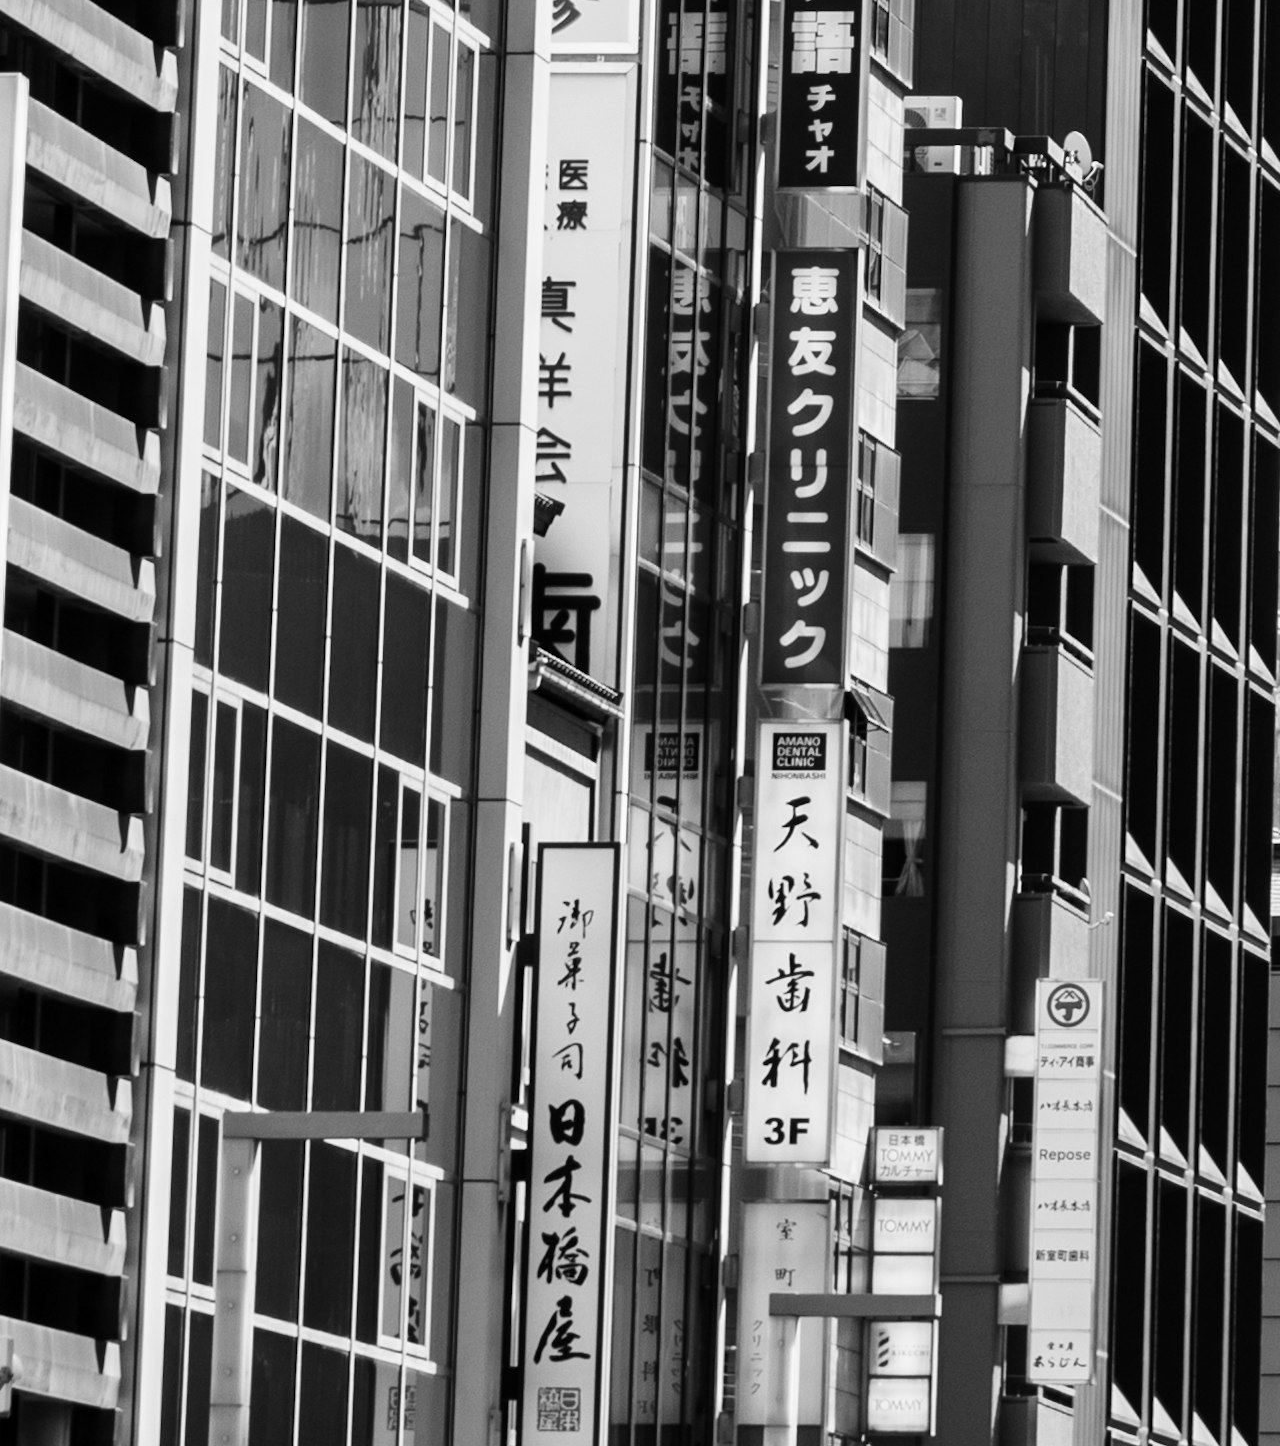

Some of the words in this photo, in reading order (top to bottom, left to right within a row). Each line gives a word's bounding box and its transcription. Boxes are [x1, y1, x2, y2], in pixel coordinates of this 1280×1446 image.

[805, 84, 837, 175] チャオ
[779, 265, 844, 670] 恵友クリニック
[777, 736, 821, 746] AMANO
[776, 746, 822, 757] DENTAL
[776, 756, 815, 767] CLINIC
[760, 796, 822, 1097] 天野歯科
[763, 1117, 810, 1147] 3F
[888, 1134, 926, 1146] 日本橋
[880, 1148, 934, 1163] TOMMY
[1039, 1148, 1091, 1163] Repose
[879, 1165, 934, 1177] カルチャー
[533, 1099, 593, 1366] 日本橋屋
[878, 1219, 931, 1233] TOMMY
[1035, 1249, 1090, 1261] 新室町歯科
[751, 1319, 763, 1395] クリニック
[1033, 1356, 1087, 1368] あらじん
[873, 1398, 924, 1411] TOMMY
